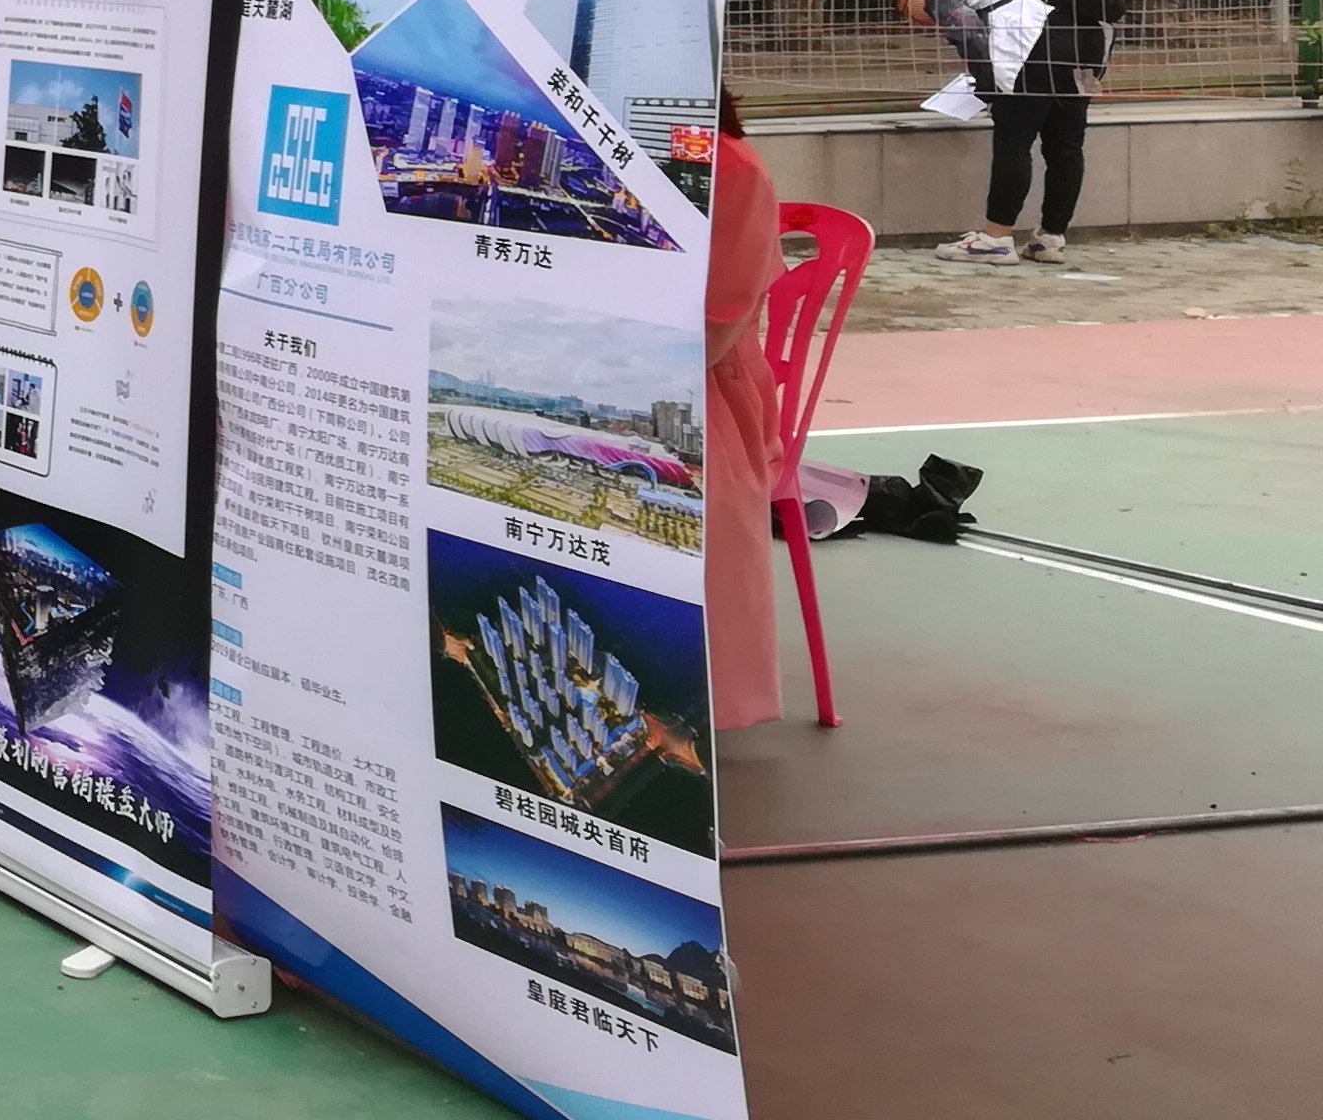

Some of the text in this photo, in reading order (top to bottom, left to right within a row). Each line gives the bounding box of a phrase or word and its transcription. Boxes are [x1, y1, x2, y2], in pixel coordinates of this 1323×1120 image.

[473, 233, 554, 270] 青秀万达
[256, 271, 329, 305] 广西分公司
[263, 330, 317, 359] 关于我们
[505, 515, 612, 568] 南宁万达茂
[494, 784, 651, 865] 碧桂园城央首府
[526, 976, 661, 1056] 皇庭君临天下
